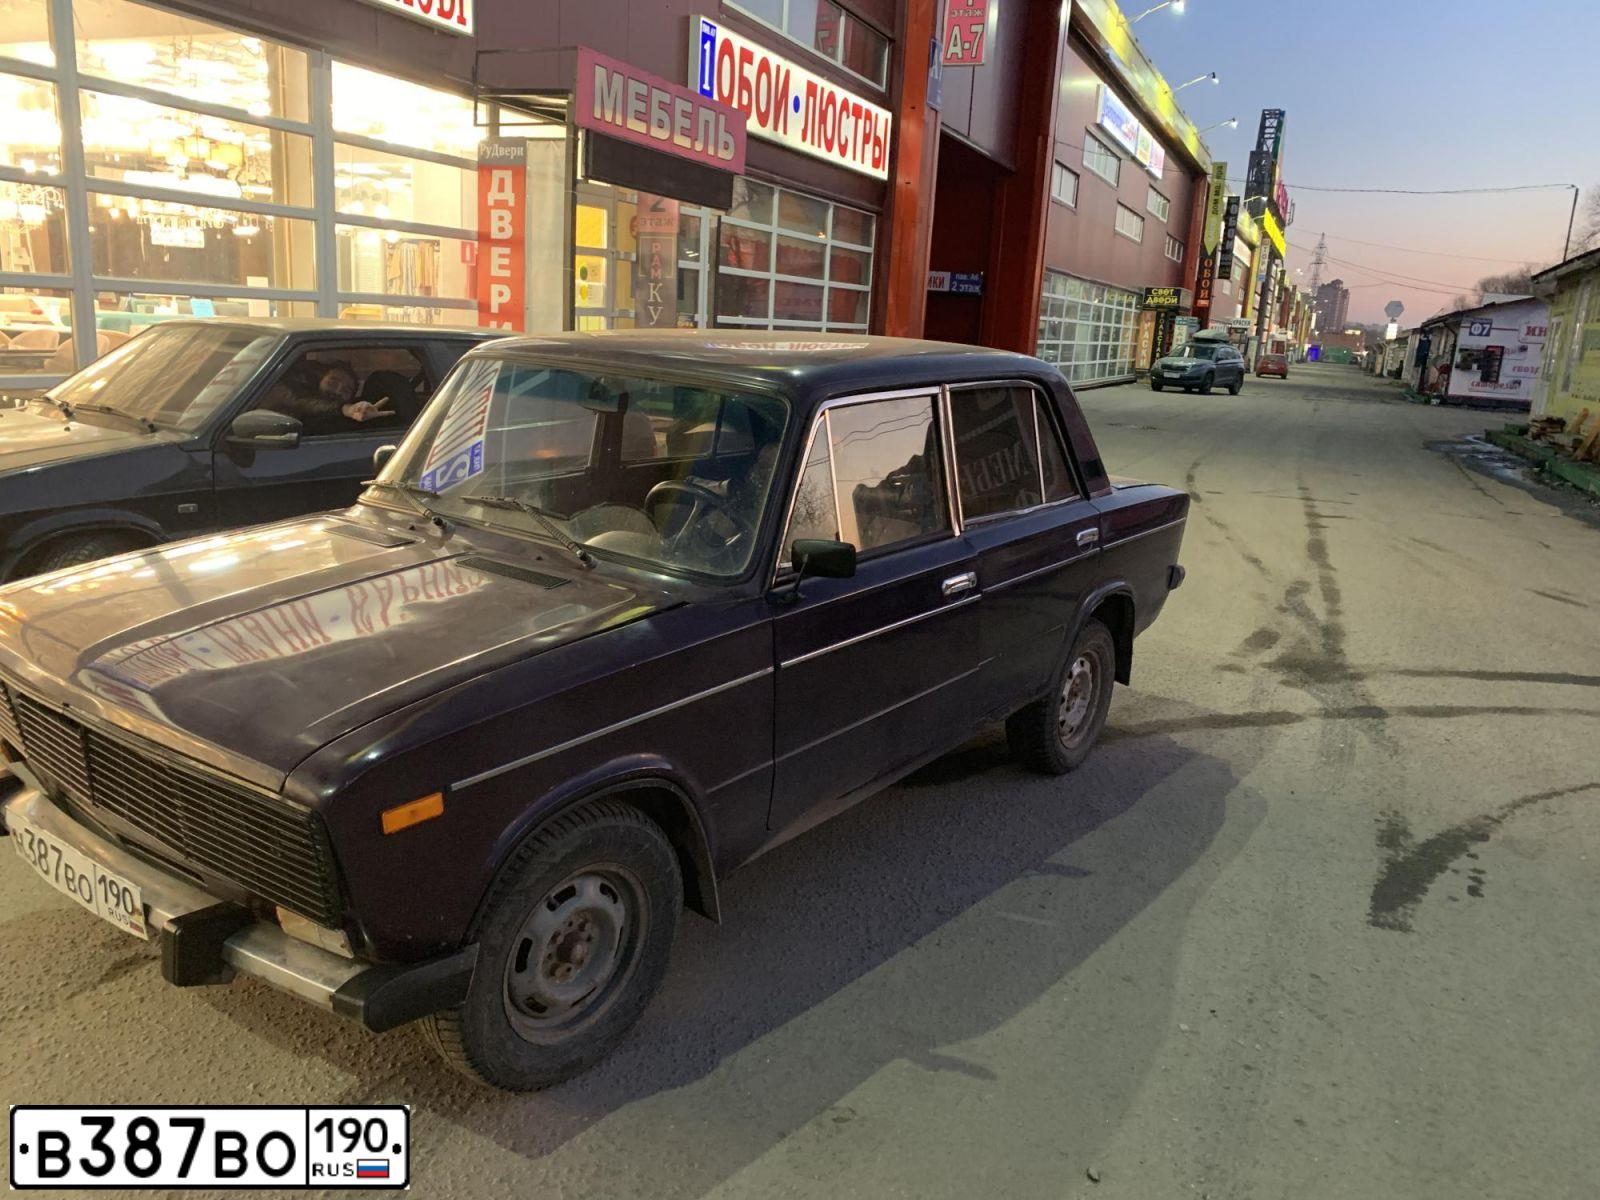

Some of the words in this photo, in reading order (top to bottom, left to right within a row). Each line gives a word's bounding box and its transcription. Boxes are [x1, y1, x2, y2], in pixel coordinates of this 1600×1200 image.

[945, 24, 984, 60] А-7
[704, 40, 711, 91] 1
[593, 64, 735, 161] МЕБЕЛЬ
[717, 38, 791, 136] ОБОИ
[802, 79, 888, 172] ЛЮСТРЫ
[480, 143, 524, 160] РуДвери
[951, 281, 958, 292] 2
[1200, 258, 1213, 298] ОБОИ
[98, 874, 134, 915] 190
[107, 907, 130, 926] RUS
